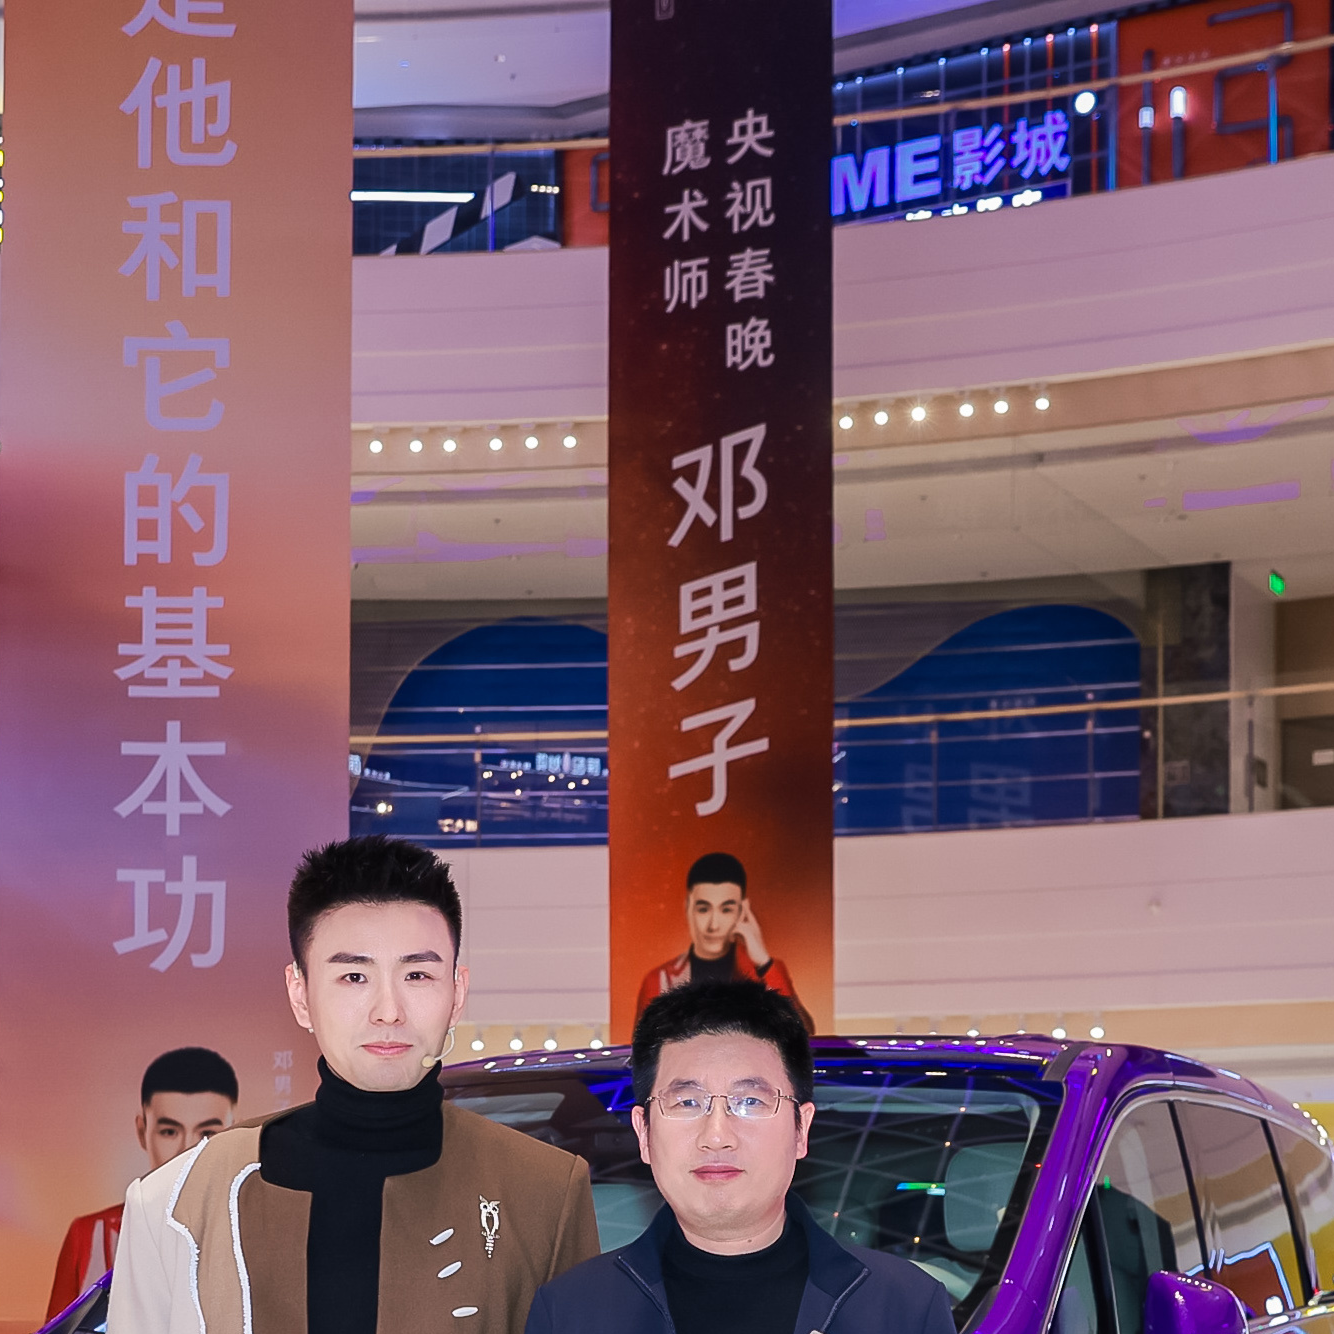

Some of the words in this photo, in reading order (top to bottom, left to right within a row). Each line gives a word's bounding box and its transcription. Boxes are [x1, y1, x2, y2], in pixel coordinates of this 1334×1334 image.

[662, 118, 712, 314] 魔术师
[724, 107, 776, 372] 央视春晚
[667, 422, 770, 818] 邓男子
